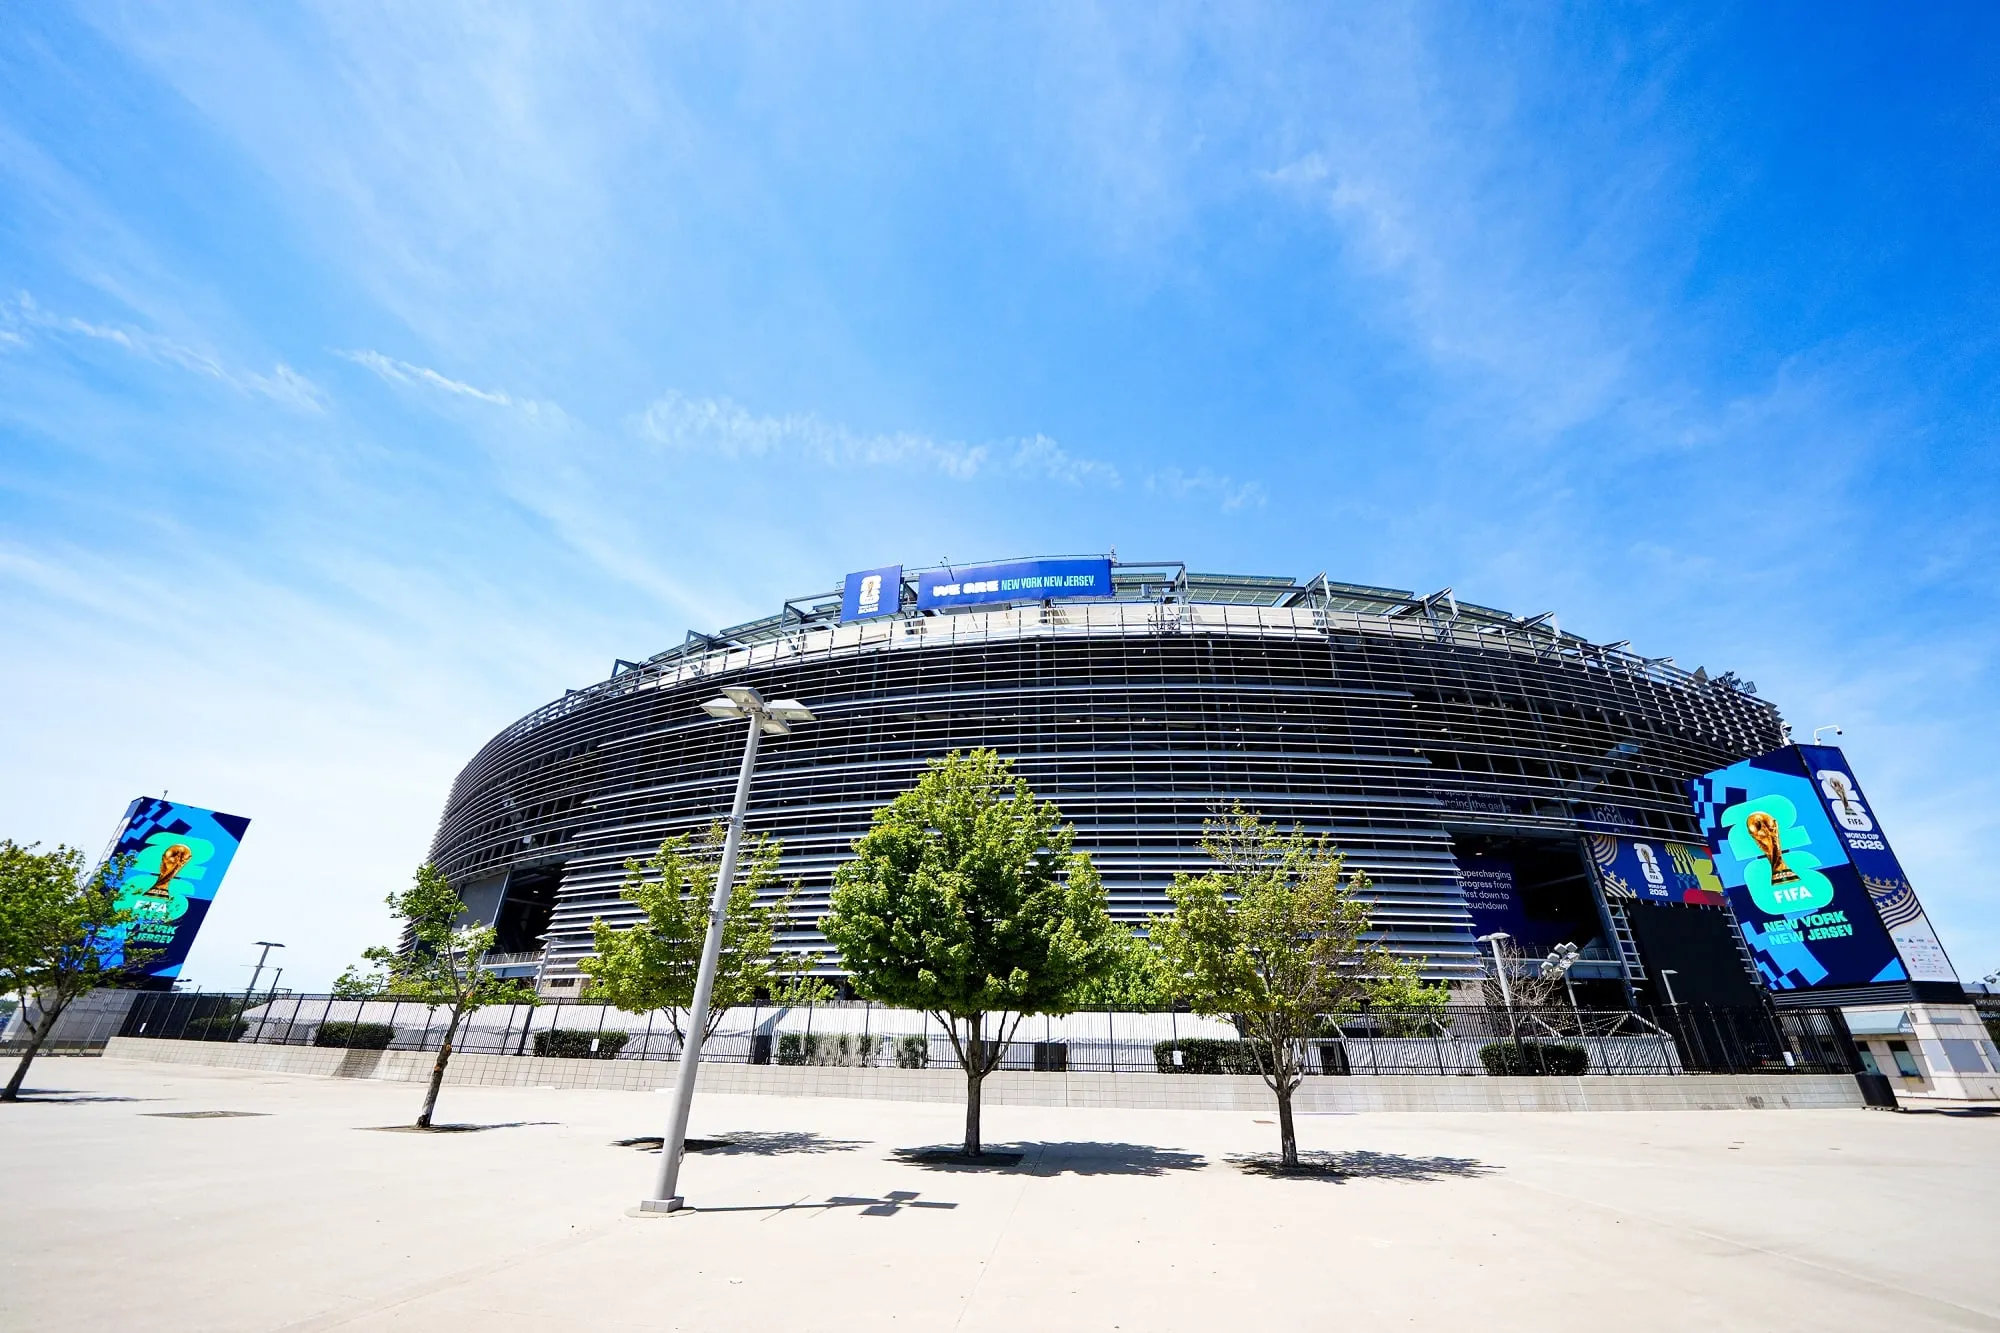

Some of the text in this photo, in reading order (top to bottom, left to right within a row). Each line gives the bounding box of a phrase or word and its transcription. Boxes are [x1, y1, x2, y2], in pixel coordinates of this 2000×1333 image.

[932, 584, 961, 597] WE
[963, 581, 999, 594] ARE
[1001, 579, 1020, 591] NEW
[1021, 577, 1043, 589] YORK
[1043, 576, 1062, 588] NEW
[1847, 818, 1864, 826] FIFA
[1844, 832, 1867, 840] WORLD
[1848, 839, 1885, 851] 2026
[1493, 880, 1512, 889] from
[1478, 890, 1501, 899] down
[1501, 892, 1510, 900] to
[1649, 888, 1669, 897] 2026
[1773, 885, 1814, 904] FIFA
[1763, 910, 1849, 933] NEW YORK
[1768, 924, 1853, 946] NEW JERSEY
